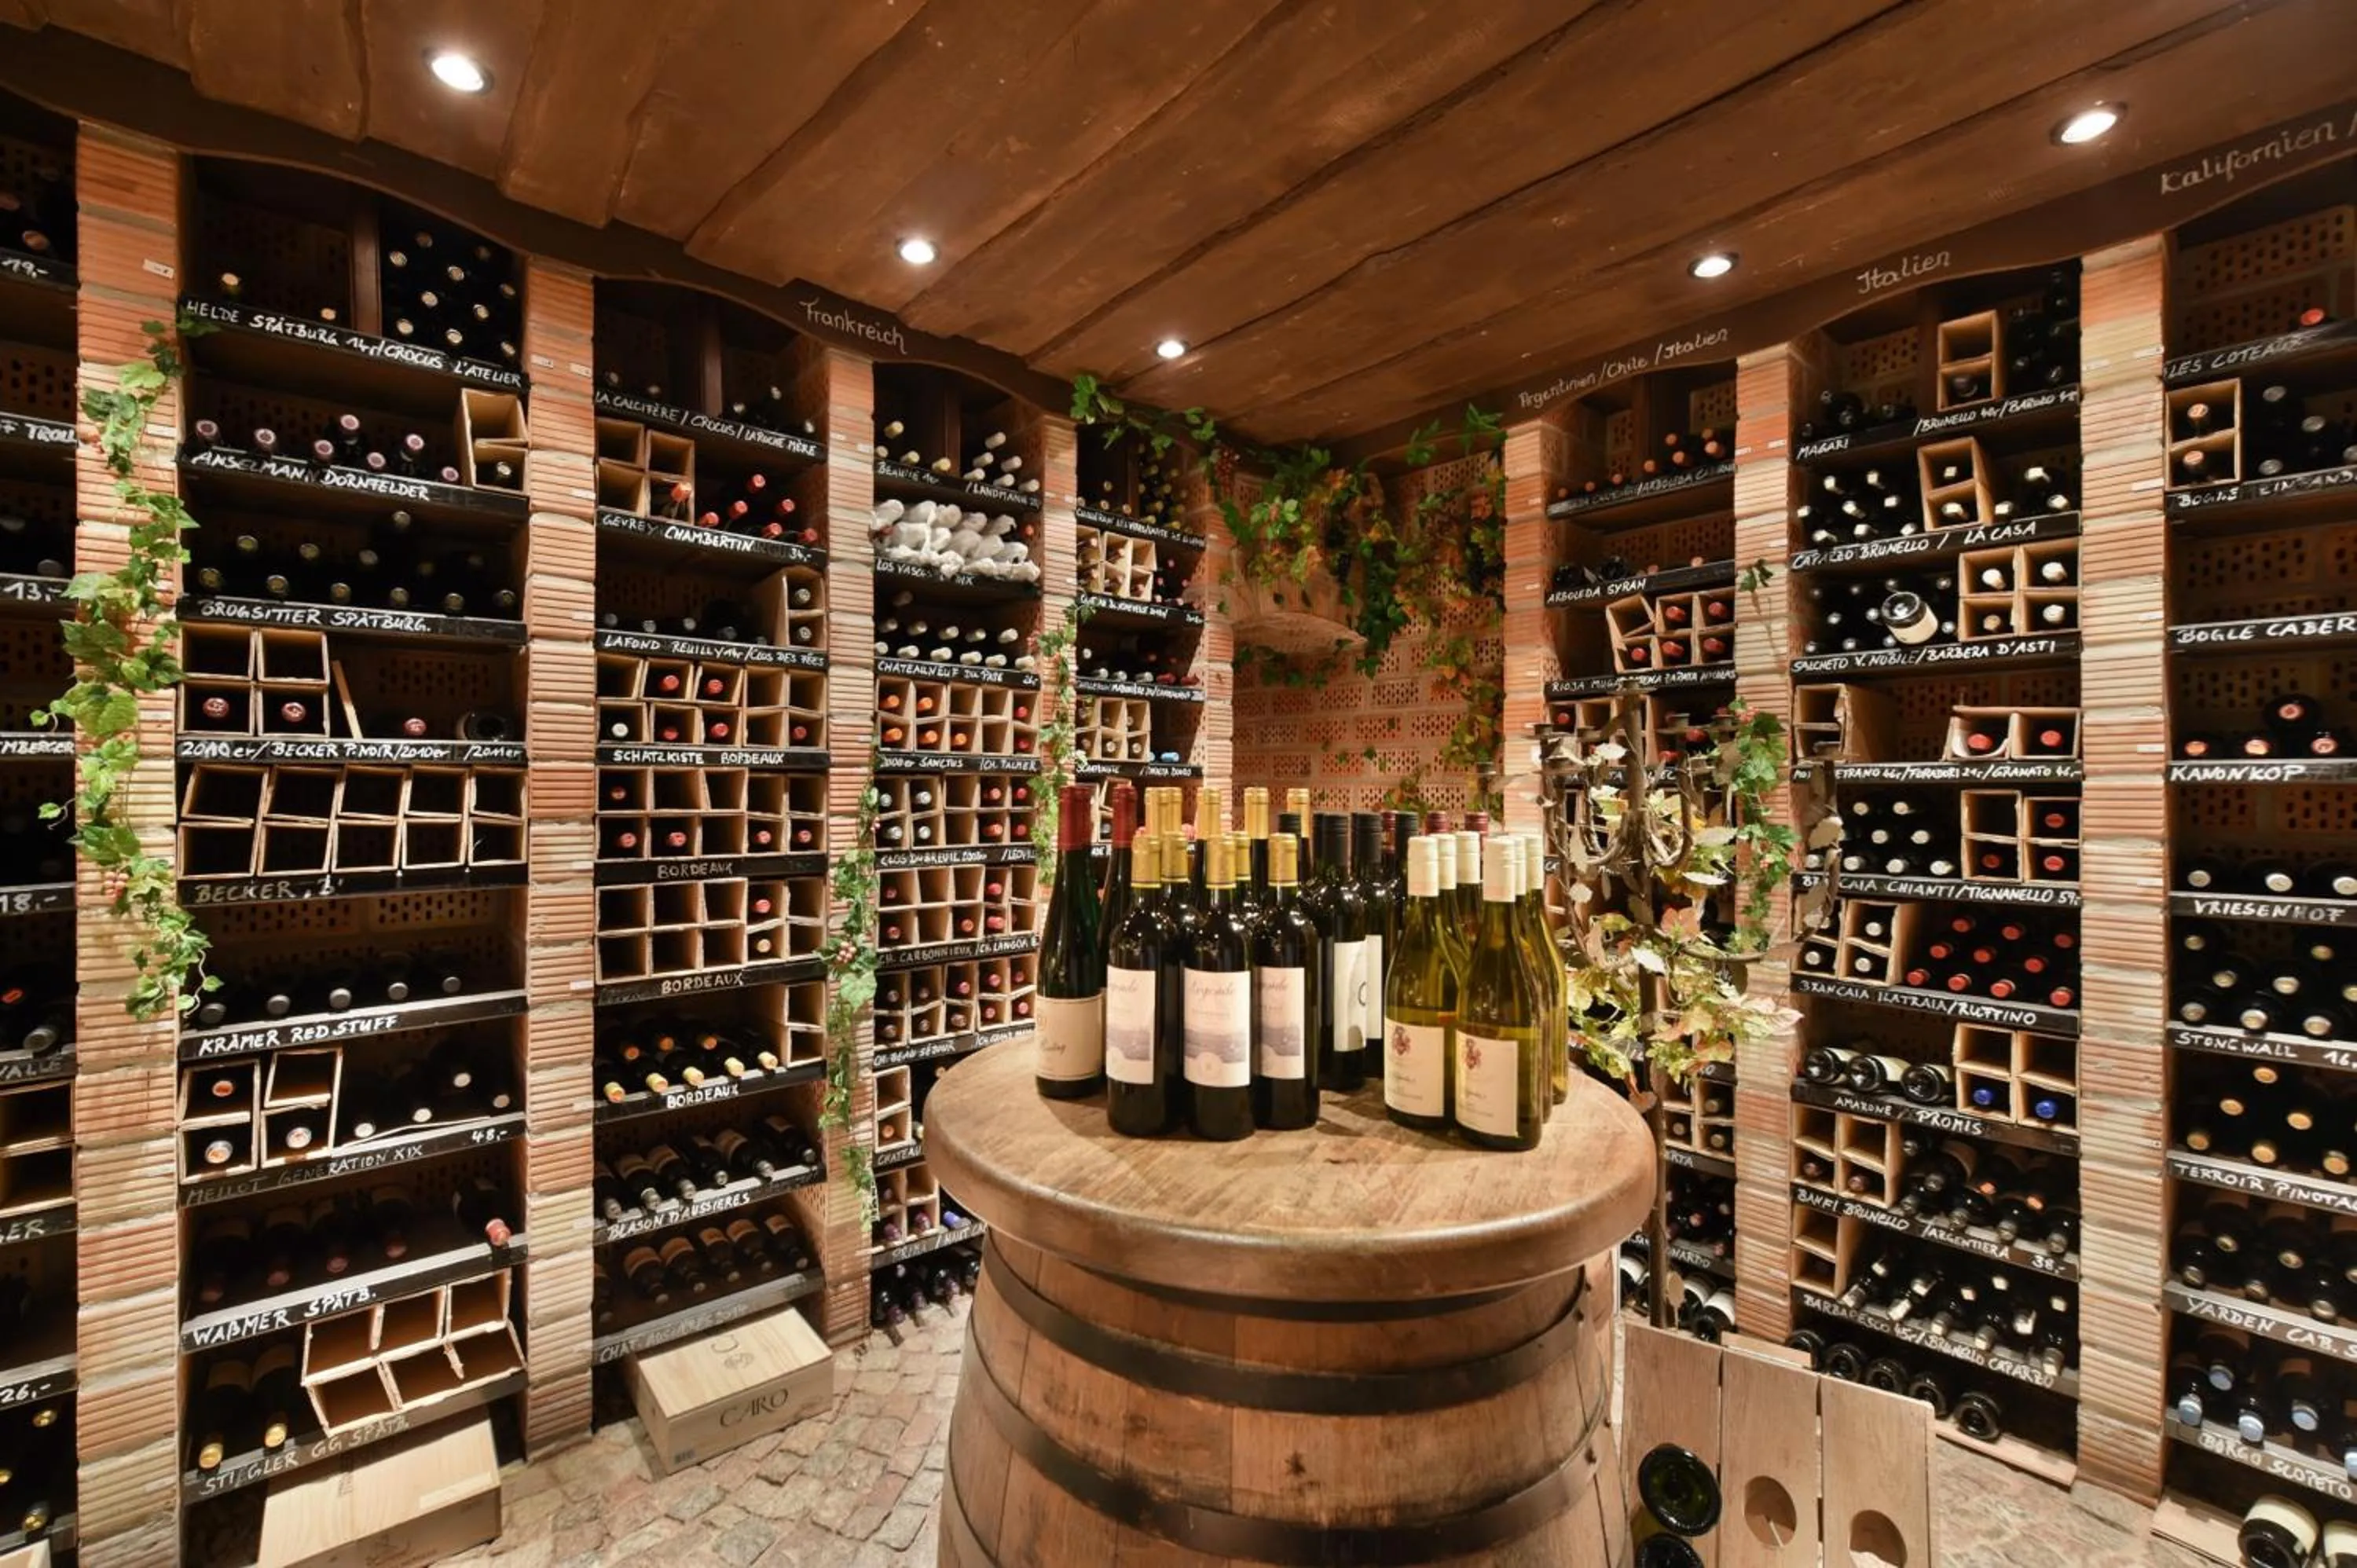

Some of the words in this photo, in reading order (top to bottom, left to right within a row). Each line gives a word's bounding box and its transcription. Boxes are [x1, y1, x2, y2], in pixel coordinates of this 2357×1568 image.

[2162, 121, 2337, 195] Kalifornien
[798, 297, 907, 354] Frankreich
[454, 360, 522, 387] L'ATELIER
[321, 471, 430, 501] DORNFELDER
[664, 526, 755, 551] CHAMBERTIN
[1859, 539, 1929, 559] BRUNELLO
[1990, 522, 2036, 540] CASA
[1607, 578, 1647, 595] SYRAH
[604, 635, 661, 650] LAFOND
[2176, 625, 2255, 644] BOGLE
[2266, 617, 2357, 637] CABER
[1996, 640, 2055, 655] D'ASTI
[0, 740, 75, 756] MBERGER
[271, 742, 339, 758] BECKER
[613, 749, 704, 764] SCHATZKISTE
[720, 752, 785, 765] BORDEAUX
[2170, 764, 2306, 781] KANONKOP
[657, 863, 733, 879] BORDEAUX
[195, 880, 295, 904] BECKER
[2194, 899, 2345, 922] VRIESENHOF
[662, 972, 744, 995] BORDEAUX
[291, 1025, 328, 1044] RED
[333, 1015, 398, 1036] STUFF
[666, 1084, 739, 1109] BORDEAUX
[1916, 1108, 1983, 1135] PROMIS
[394, 1145, 423, 1161] XIX
[2174, 1163, 2265, 1191] TERROIR
[1845, 1203, 1909, 1230] BRUNELLO
[2187, 1296, 2276, 1332] YARDEN
[719, 1388, 789, 1428] CARO
[2268, 1460, 2353, 1500] SCOPETO
